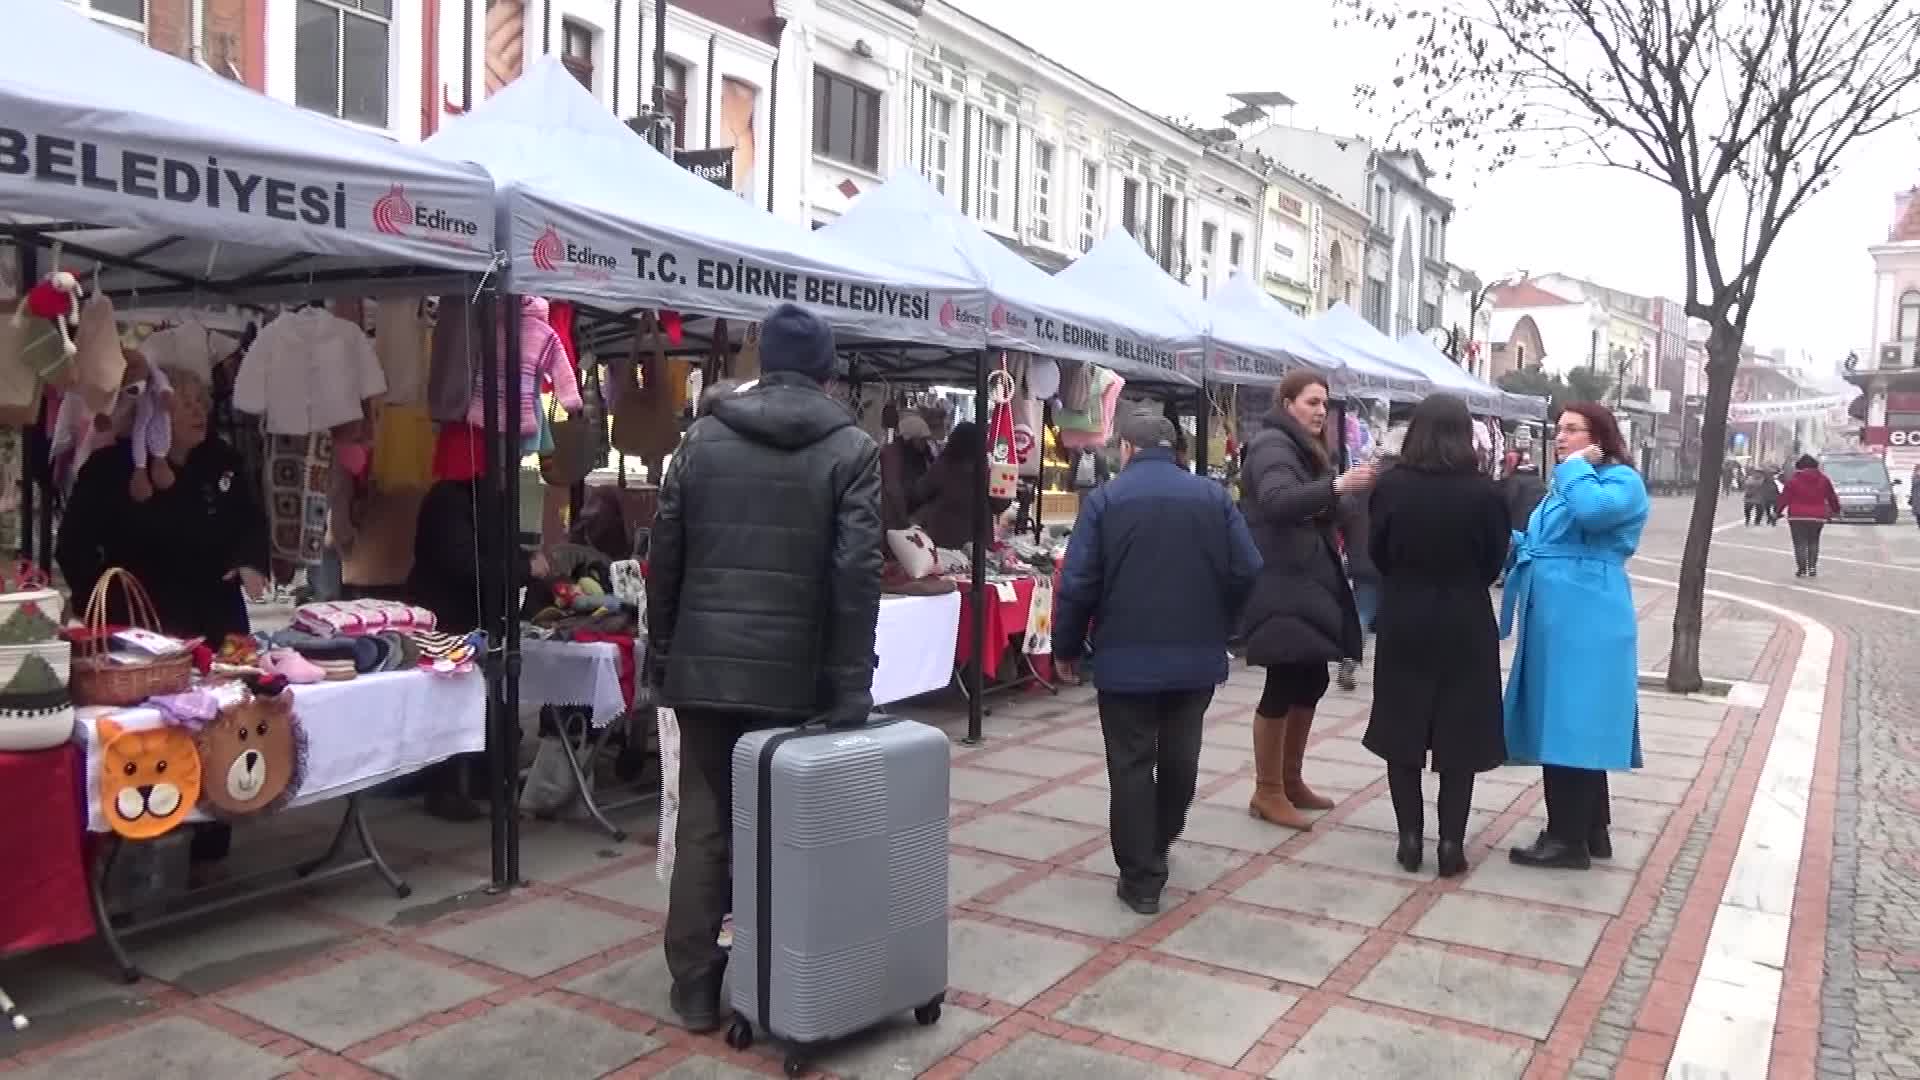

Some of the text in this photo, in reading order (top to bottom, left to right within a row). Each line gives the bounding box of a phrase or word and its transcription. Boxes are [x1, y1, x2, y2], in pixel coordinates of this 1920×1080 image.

[0, 127, 347, 229] BELEDİYESİ
[415, 205, 478, 236] Edirne
[567, 240, 617, 270] Edirne
[631, 248, 931, 321] T.C. EDİRNE BELEDİYESİ
[1033, 316, 1059, 342] T.C.
